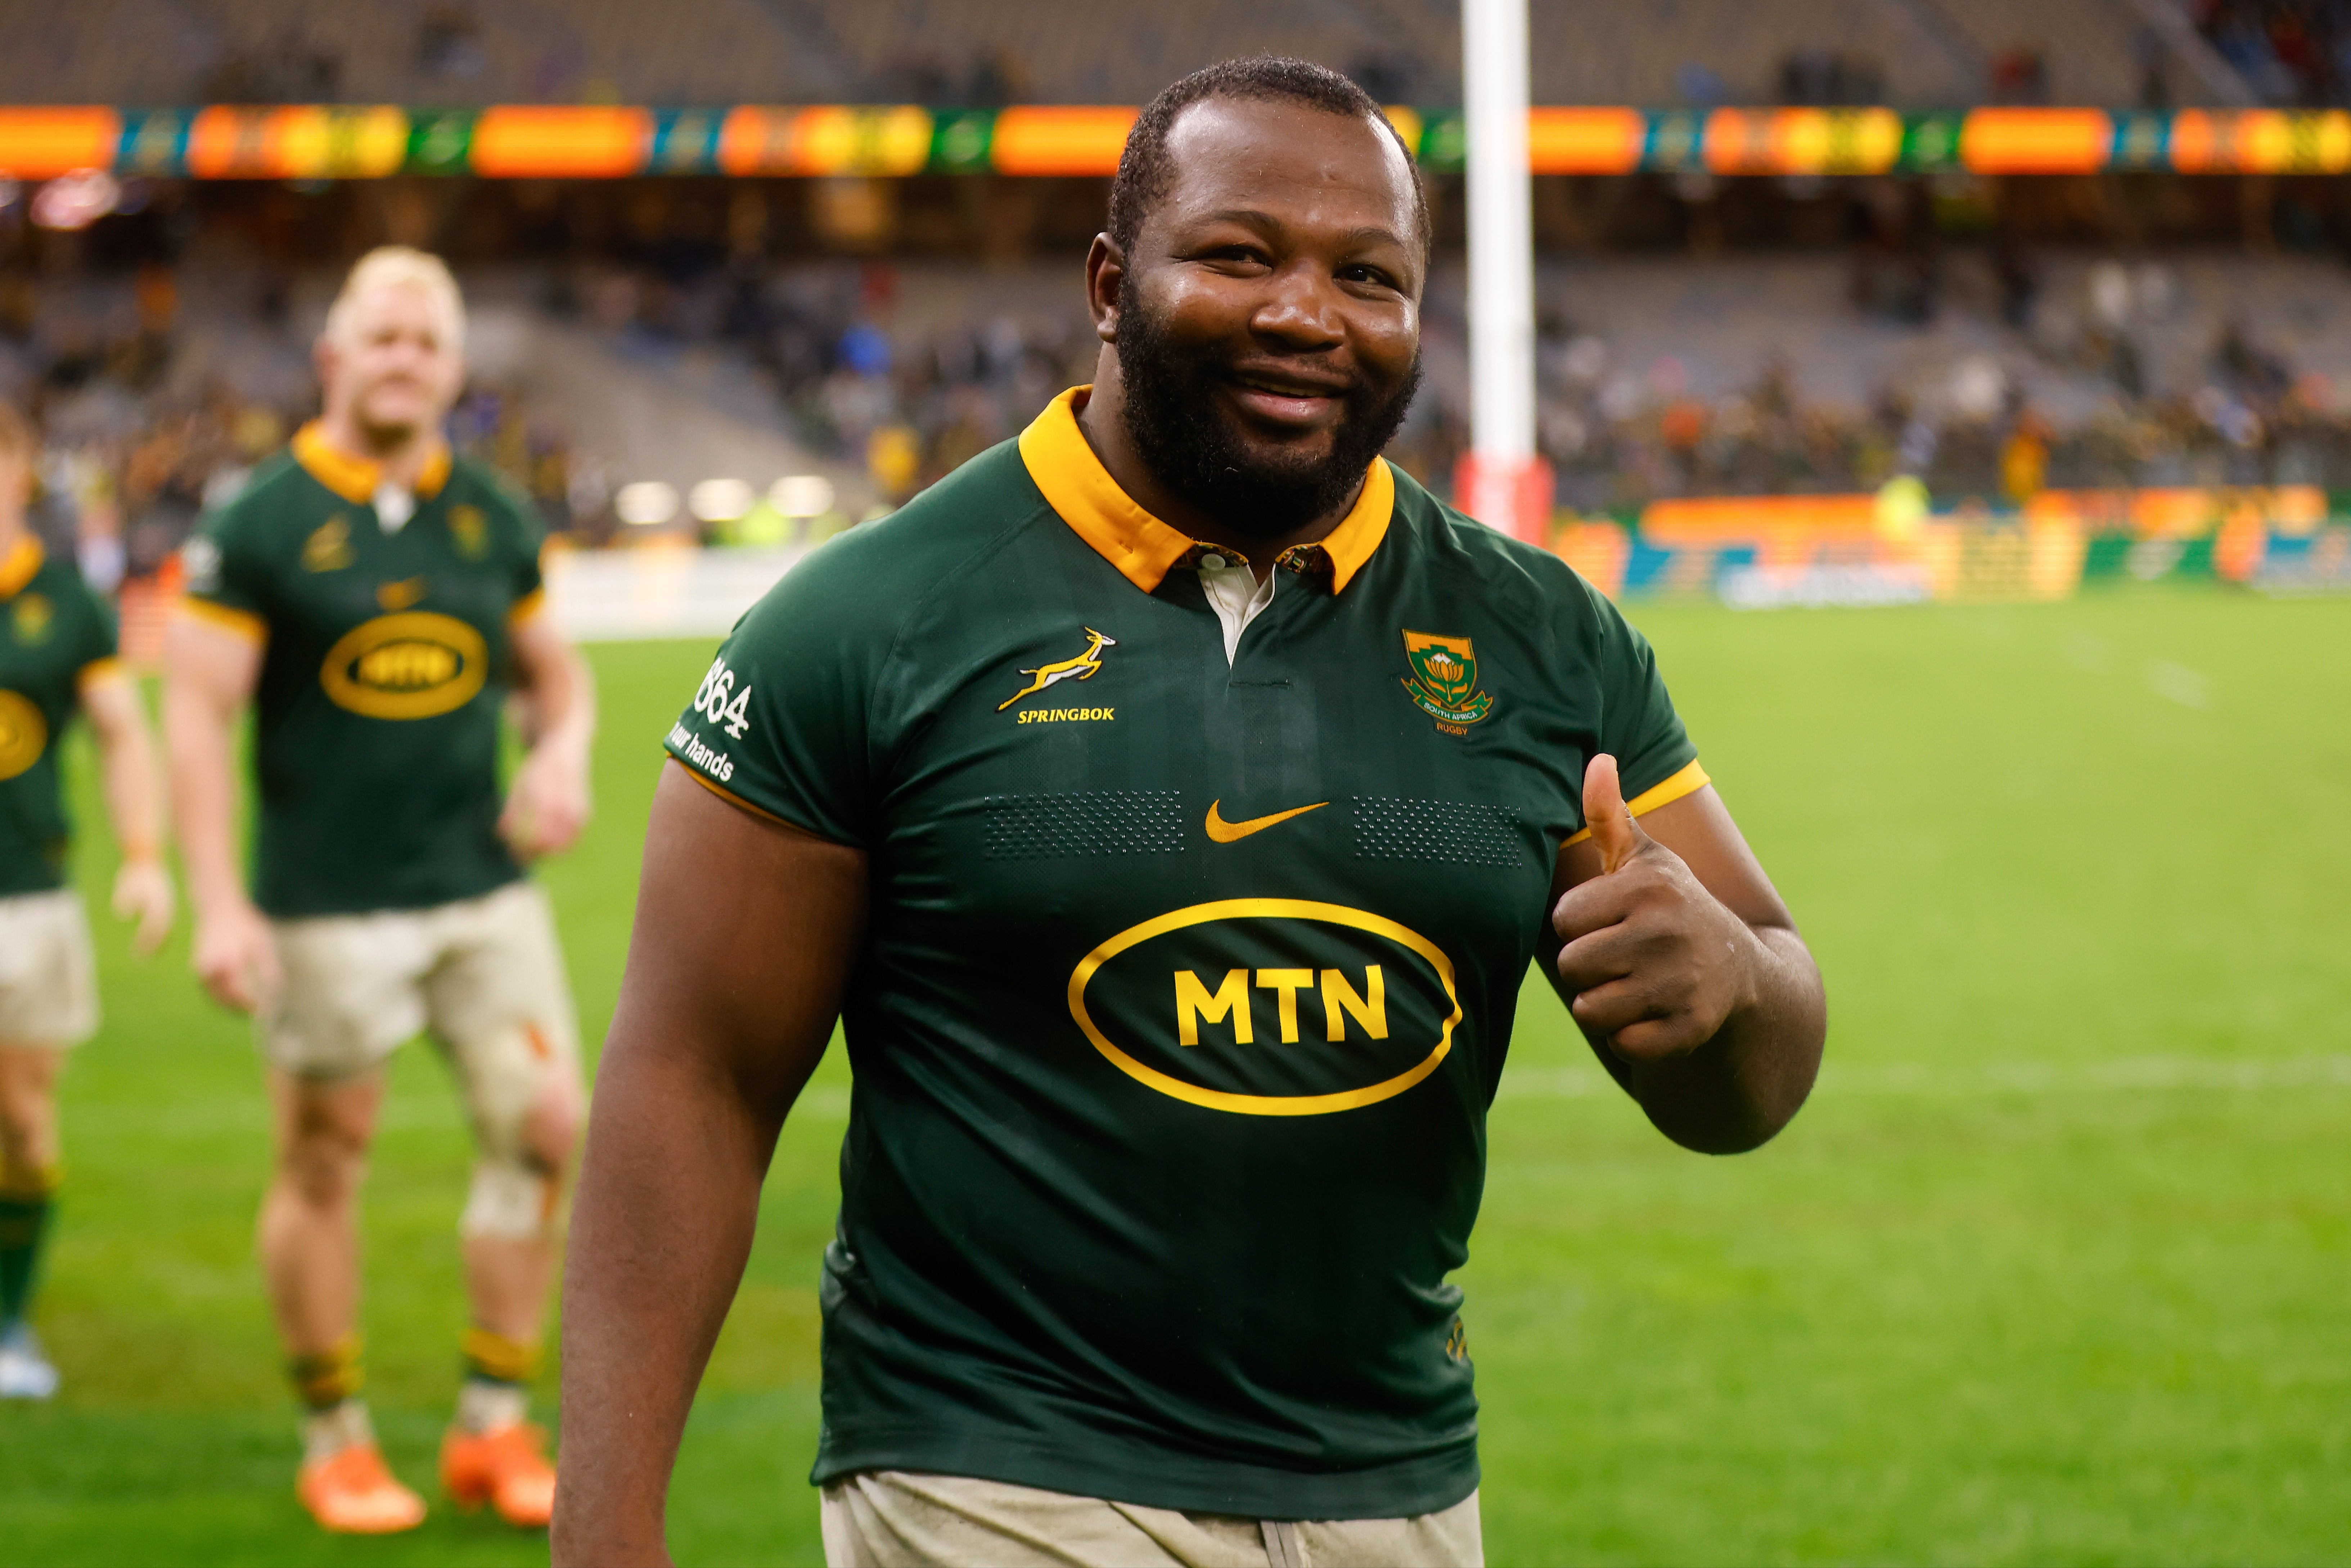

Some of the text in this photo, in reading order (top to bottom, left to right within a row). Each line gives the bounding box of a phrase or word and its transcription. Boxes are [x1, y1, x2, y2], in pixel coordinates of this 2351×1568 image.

[1017, 708, 1115, 724] SPRINGBOK
[1424, 702, 1478, 720] SOUTH AFRICA
[1436, 722, 1468, 735] RUGBY
[685, 732, 734, 782] hands
[1174, 964, 1388, 1046] MTN
